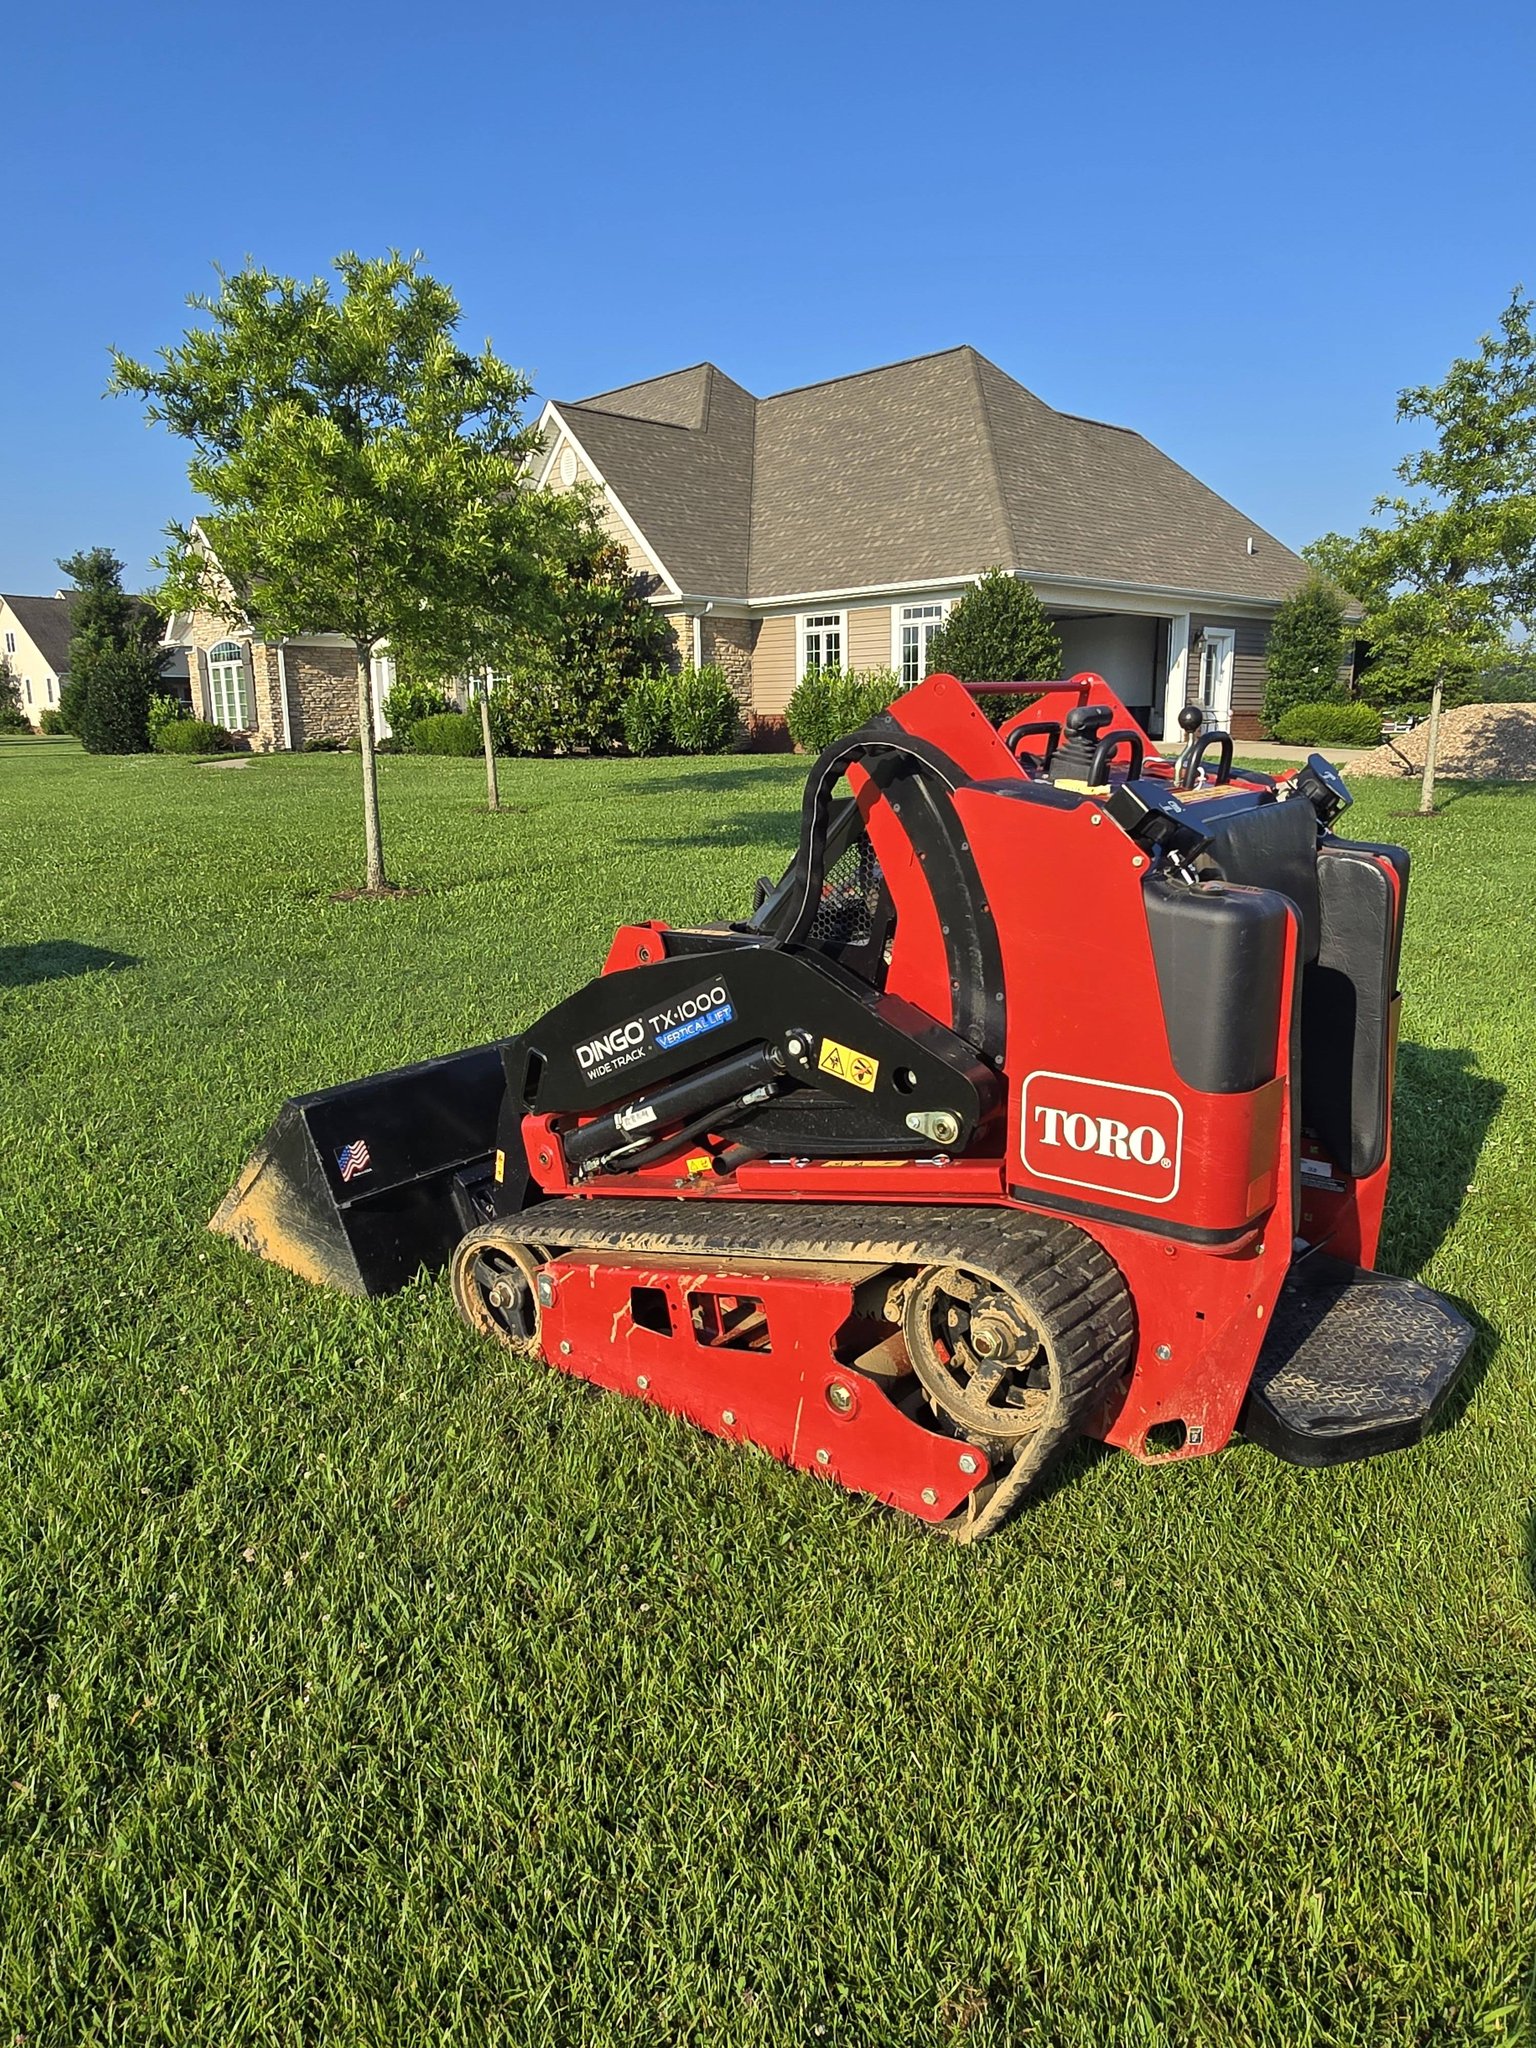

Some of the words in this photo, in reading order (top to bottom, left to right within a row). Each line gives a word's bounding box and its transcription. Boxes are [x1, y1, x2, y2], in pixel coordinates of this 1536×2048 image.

[576, 1021, 645, 1069] DINGO
[659, 1018, 708, 1046] VERTICAL
[709, 1007, 731, 1024] LIFT
[587, 1062, 613, 1080] WIDE
[612, 1047, 646, 1069] TRACK
[1034, 1105, 1166, 1165] TORO
